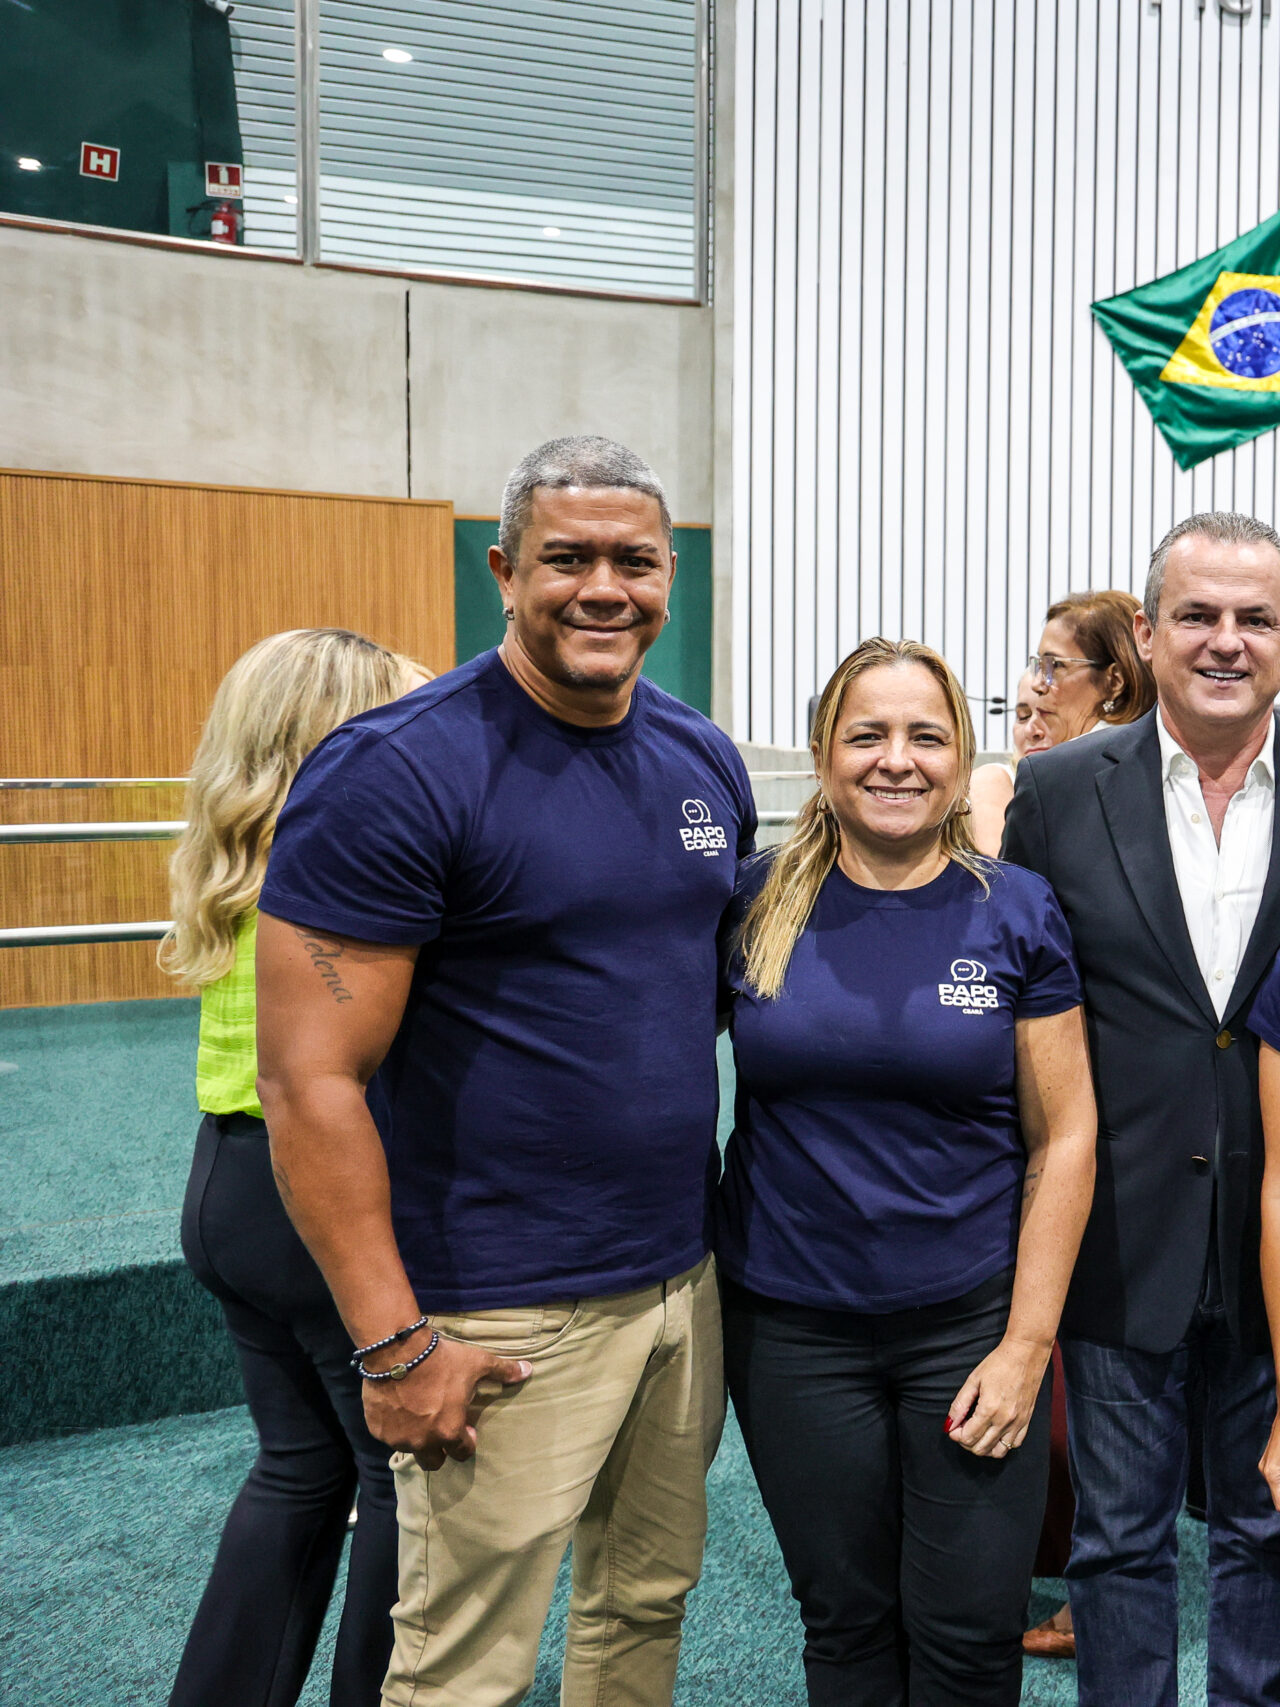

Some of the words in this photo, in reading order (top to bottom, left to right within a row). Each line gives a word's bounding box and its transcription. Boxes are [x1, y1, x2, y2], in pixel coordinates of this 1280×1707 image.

[89, 151, 111, 174] H
[679, 826, 725, 841] PAPO
[683, 838, 727, 851] CONDO
[938, 984, 998, 998] PAPO
[940, 996, 999, 1008] CONDO
